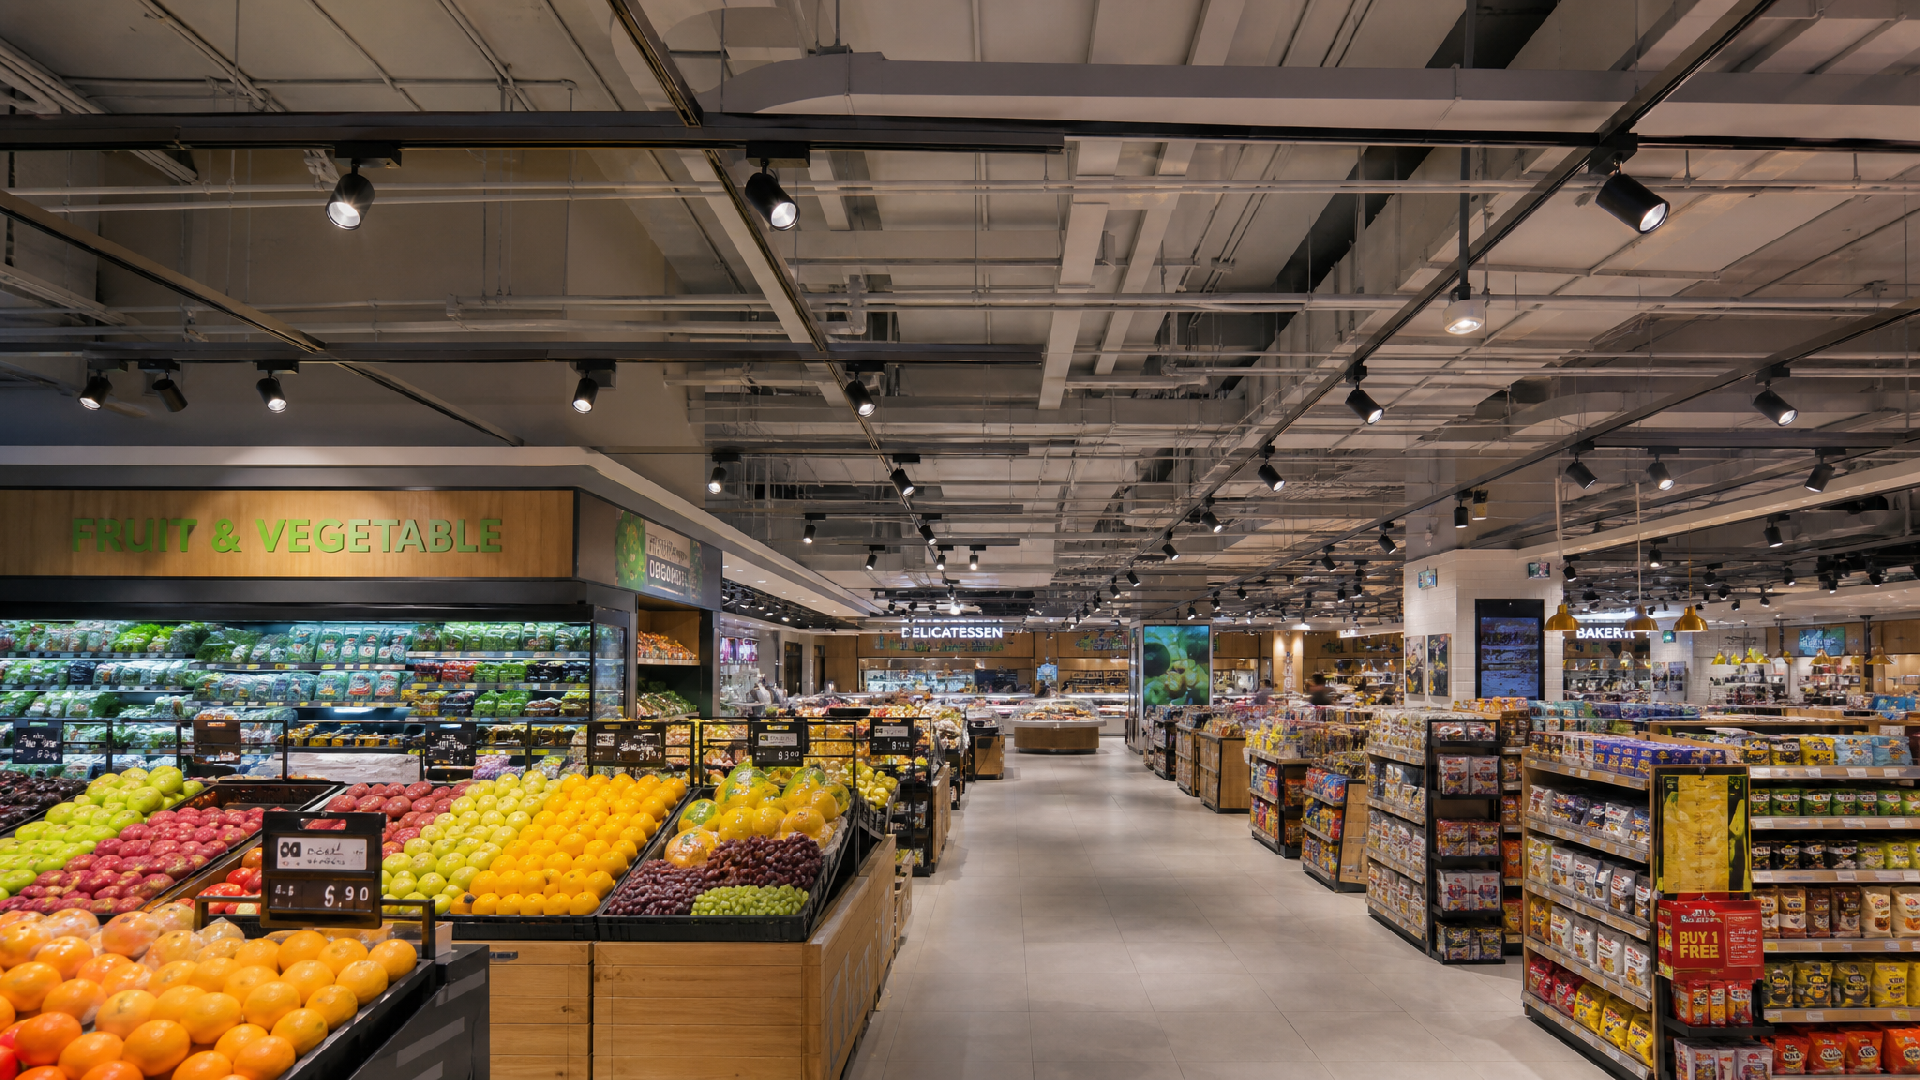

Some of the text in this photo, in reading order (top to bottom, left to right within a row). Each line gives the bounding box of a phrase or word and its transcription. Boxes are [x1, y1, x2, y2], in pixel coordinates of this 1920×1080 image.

[72, 518, 503, 553] FRUIT & VEGETABLE
[901, 627, 1003, 639] DELICATESSEN
[1679, 931, 1718, 944] BUY 1
[1679, 944, 1720, 959] FREE
